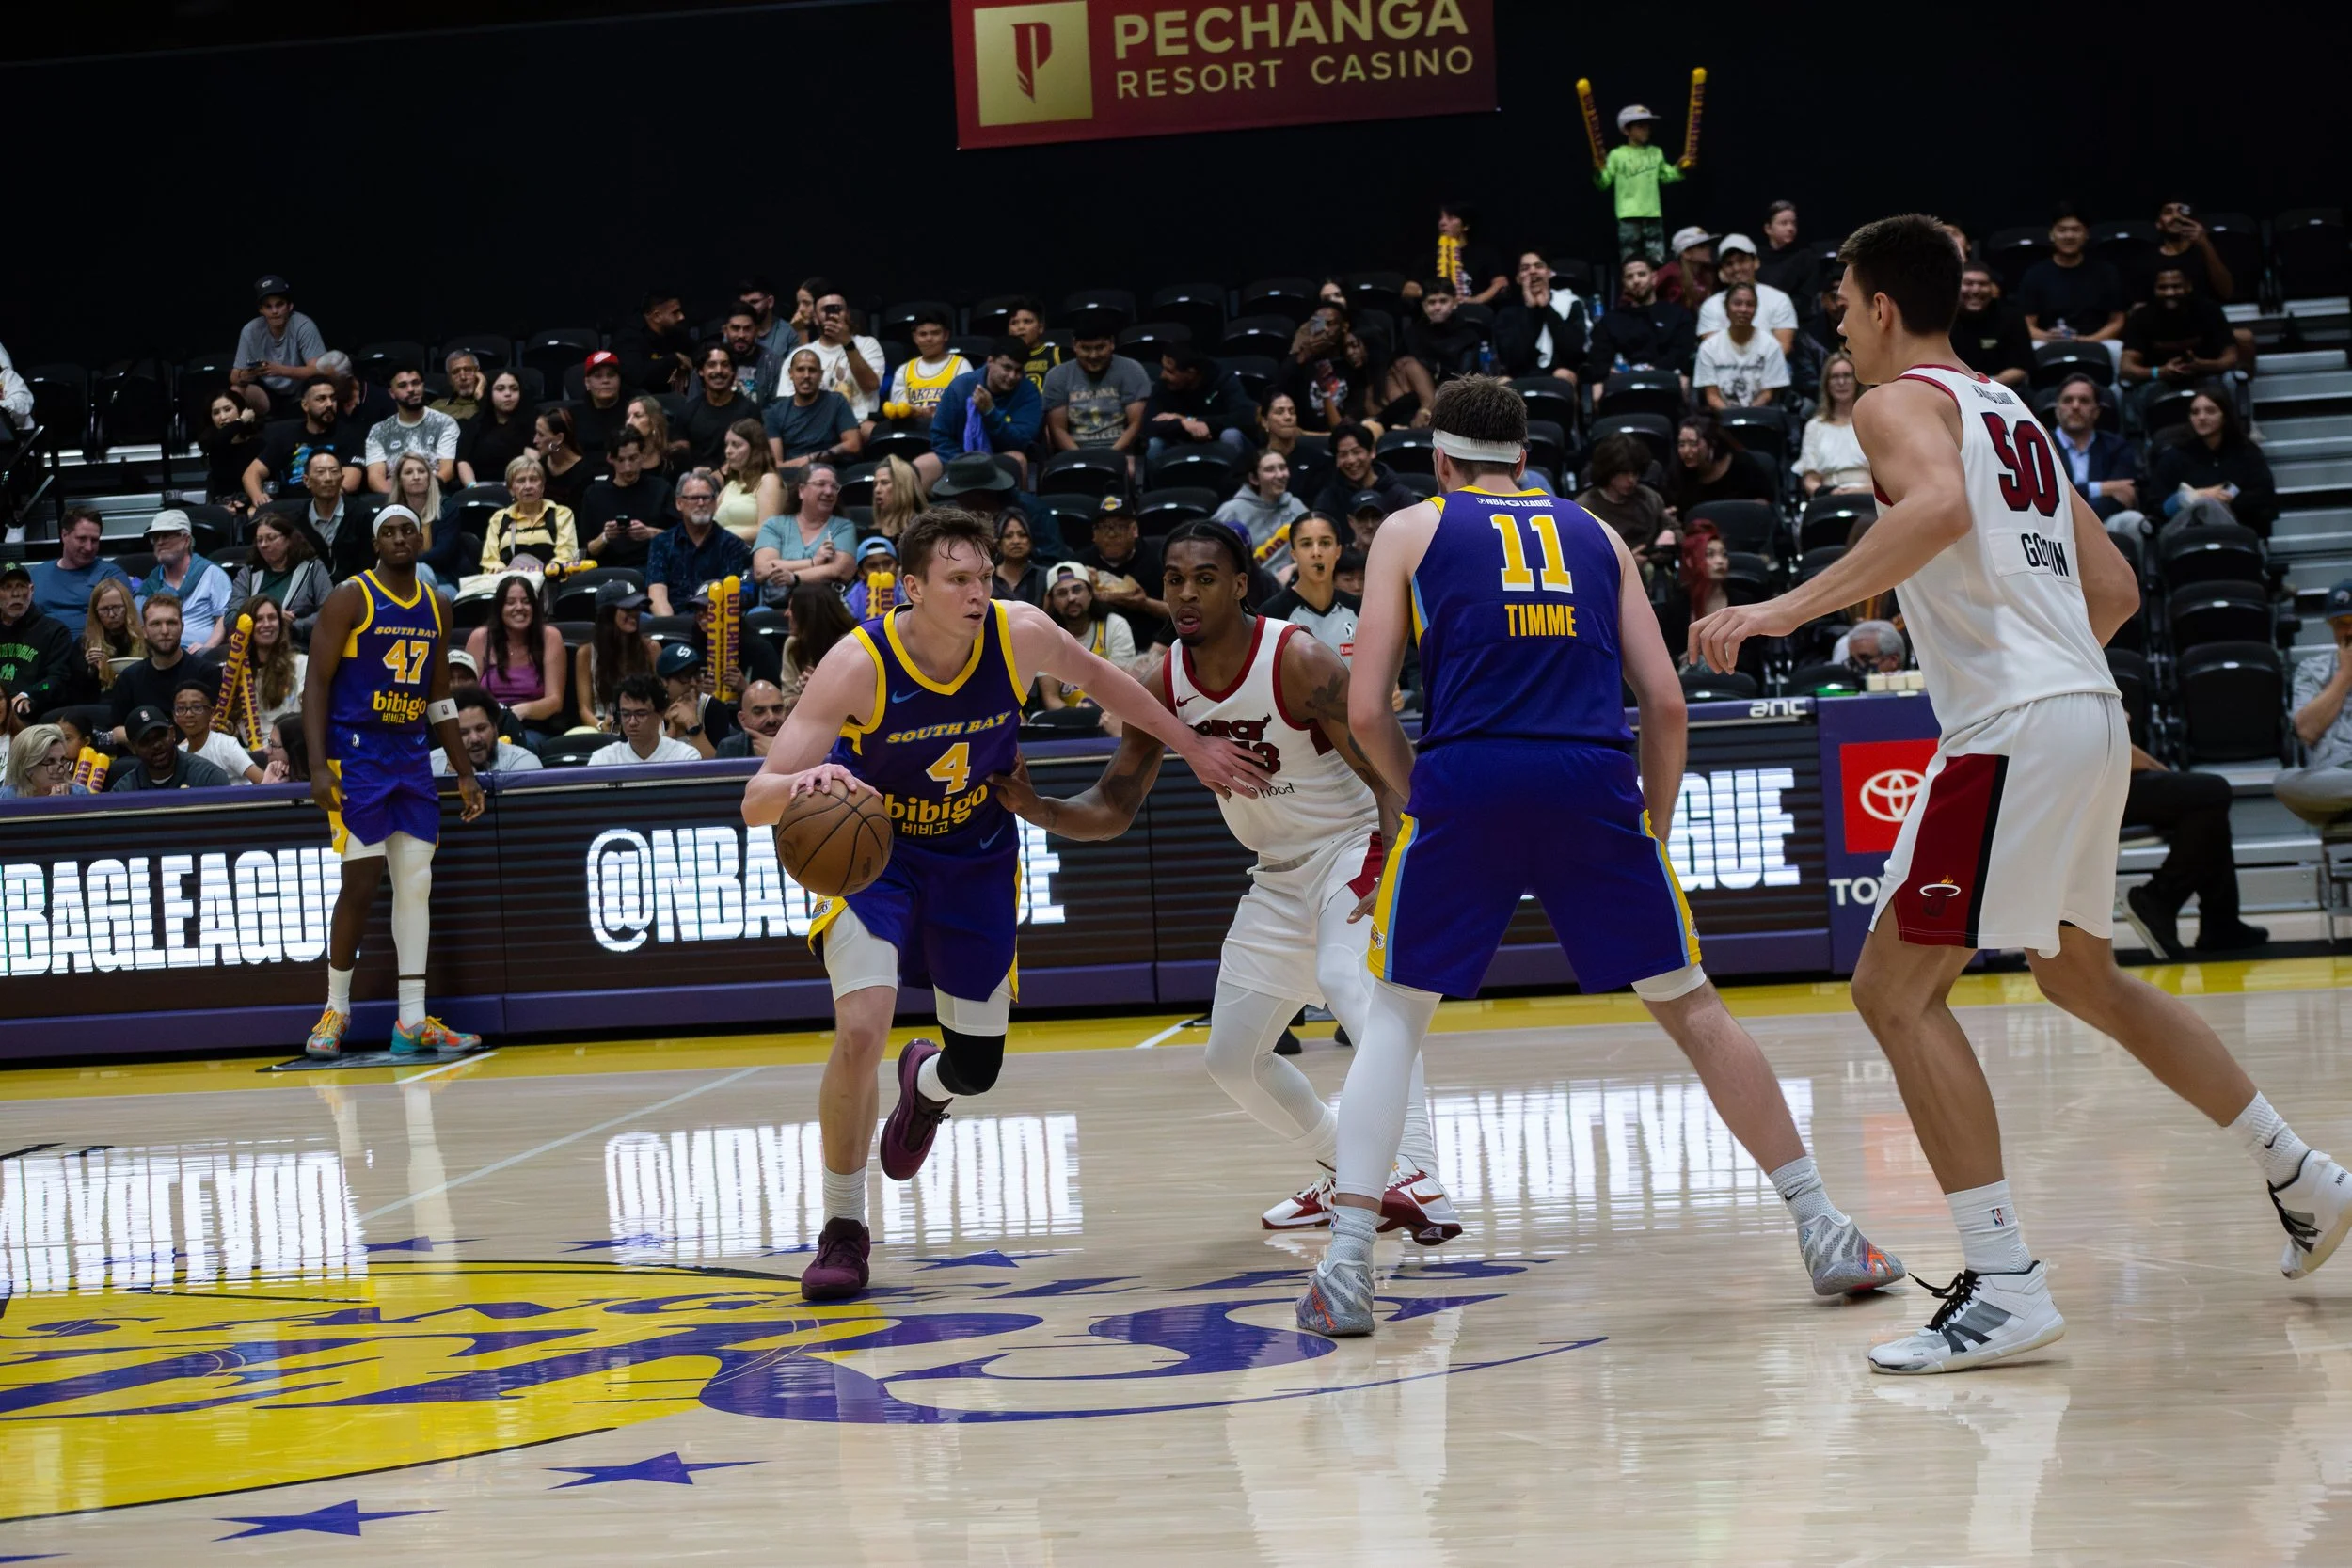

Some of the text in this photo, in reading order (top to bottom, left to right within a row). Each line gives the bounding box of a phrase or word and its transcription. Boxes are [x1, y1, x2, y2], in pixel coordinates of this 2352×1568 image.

[1113, 0, 1470, 60] PECHANGA
[1117, 45, 1474, 99] RESORT CASINO
[1980, 411, 2060, 518] 50
[1489, 513, 1574, 594] 11
[373, 626, 437, 639] SOUTH BAY
[1504, 604, 1578, 638] TIMME
[382, 639, 430, 685] 47
[373, 690, 428, 721] bibigo
[1749, 699, 1808, 718] anc
[886, 710, 1011, 744] SOUTH BAY
[925, 741, 971, 795] 4
[883, 784, 989, 825] bibigo
[901, 812, 949, 836] 비비고
